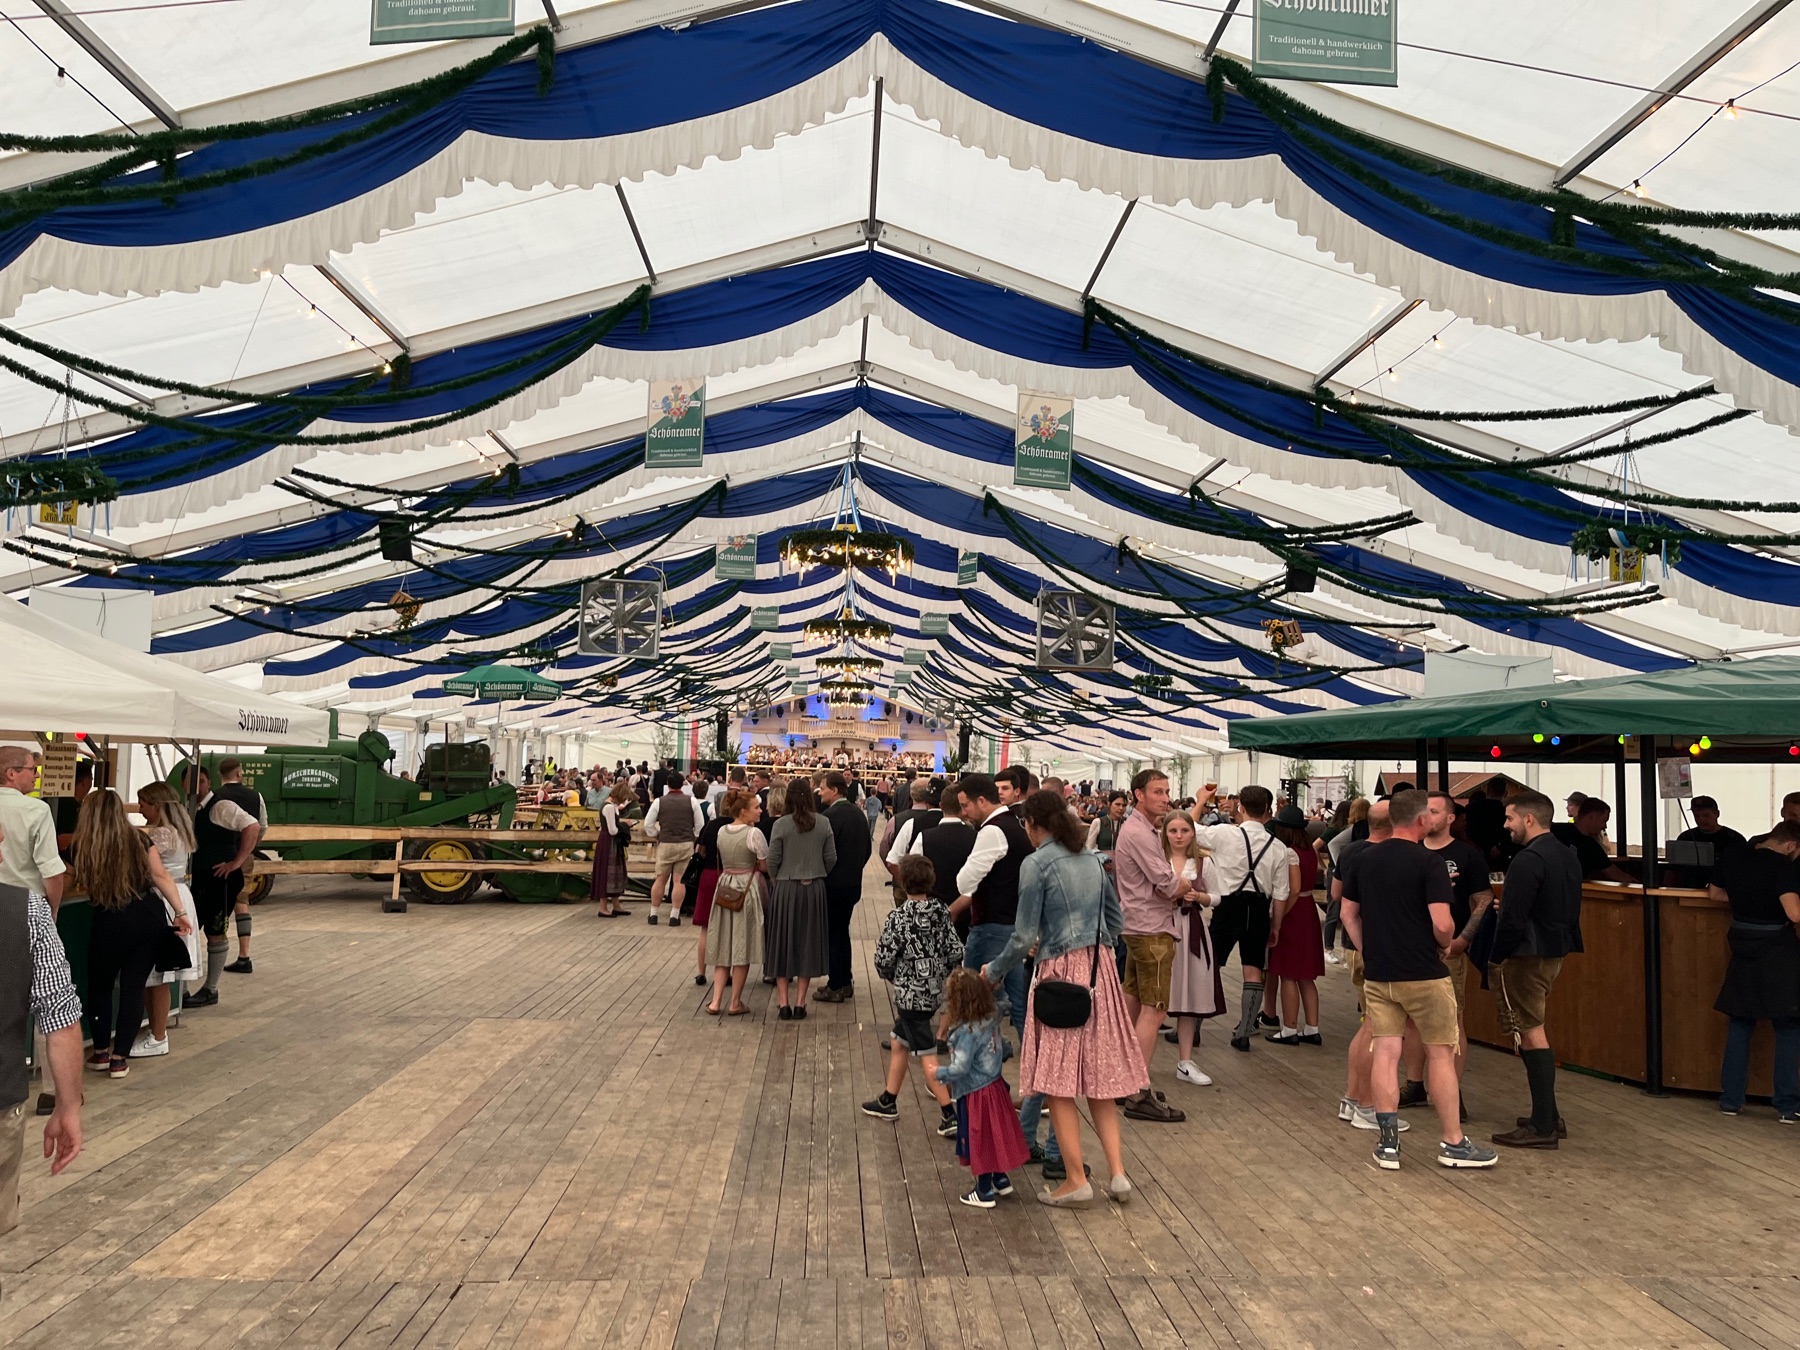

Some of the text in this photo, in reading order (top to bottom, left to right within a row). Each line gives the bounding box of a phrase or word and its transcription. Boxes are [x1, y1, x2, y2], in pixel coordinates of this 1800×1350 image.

[408, 4, 477, 16] dahoam gebraut.
[1269, 35, 1317, 46] Traditionell
[1327, 39, 1383, 50] handwerklich
[1291, 46, 1360, 59] dahoam gebraut.
[649, 427, 701, 439] Schönramer
[1019, 445, 1069, 461] Schönramer
[446, 681, 475, 691] Schönramer
[484, 682, 523, 691] Schönramer
[532, 682, 559, 694] Schönramer
[238, 708, 289, 737] Schönramer
